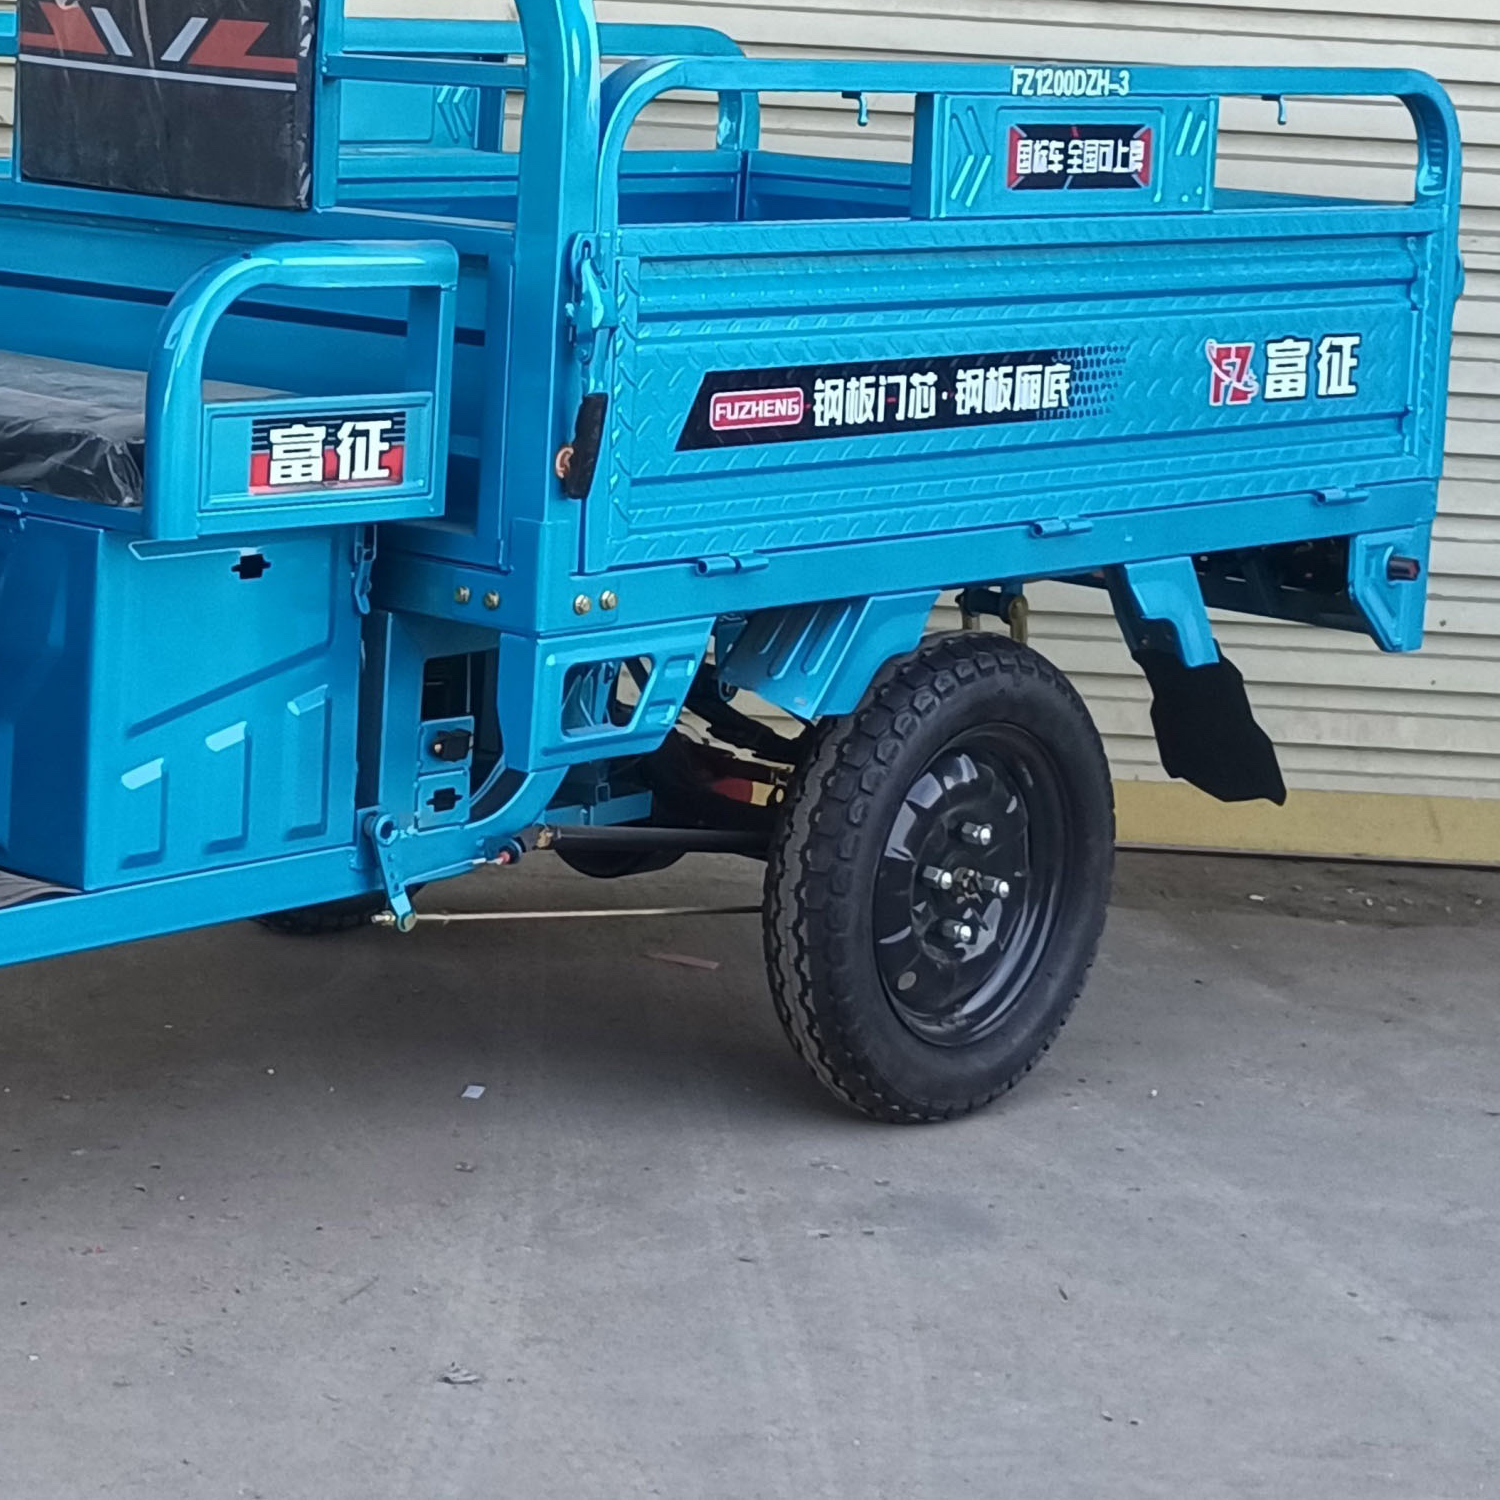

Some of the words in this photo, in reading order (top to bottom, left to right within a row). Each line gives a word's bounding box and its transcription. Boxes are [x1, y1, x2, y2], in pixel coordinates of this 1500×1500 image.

[1011, 67, 1131, 97] FZ1200DZH-3
[1263, 334, 1362, 400] 富征
[714, 396, 801, 421] FUZHENG
[269, 419, 393, 485] 富征
